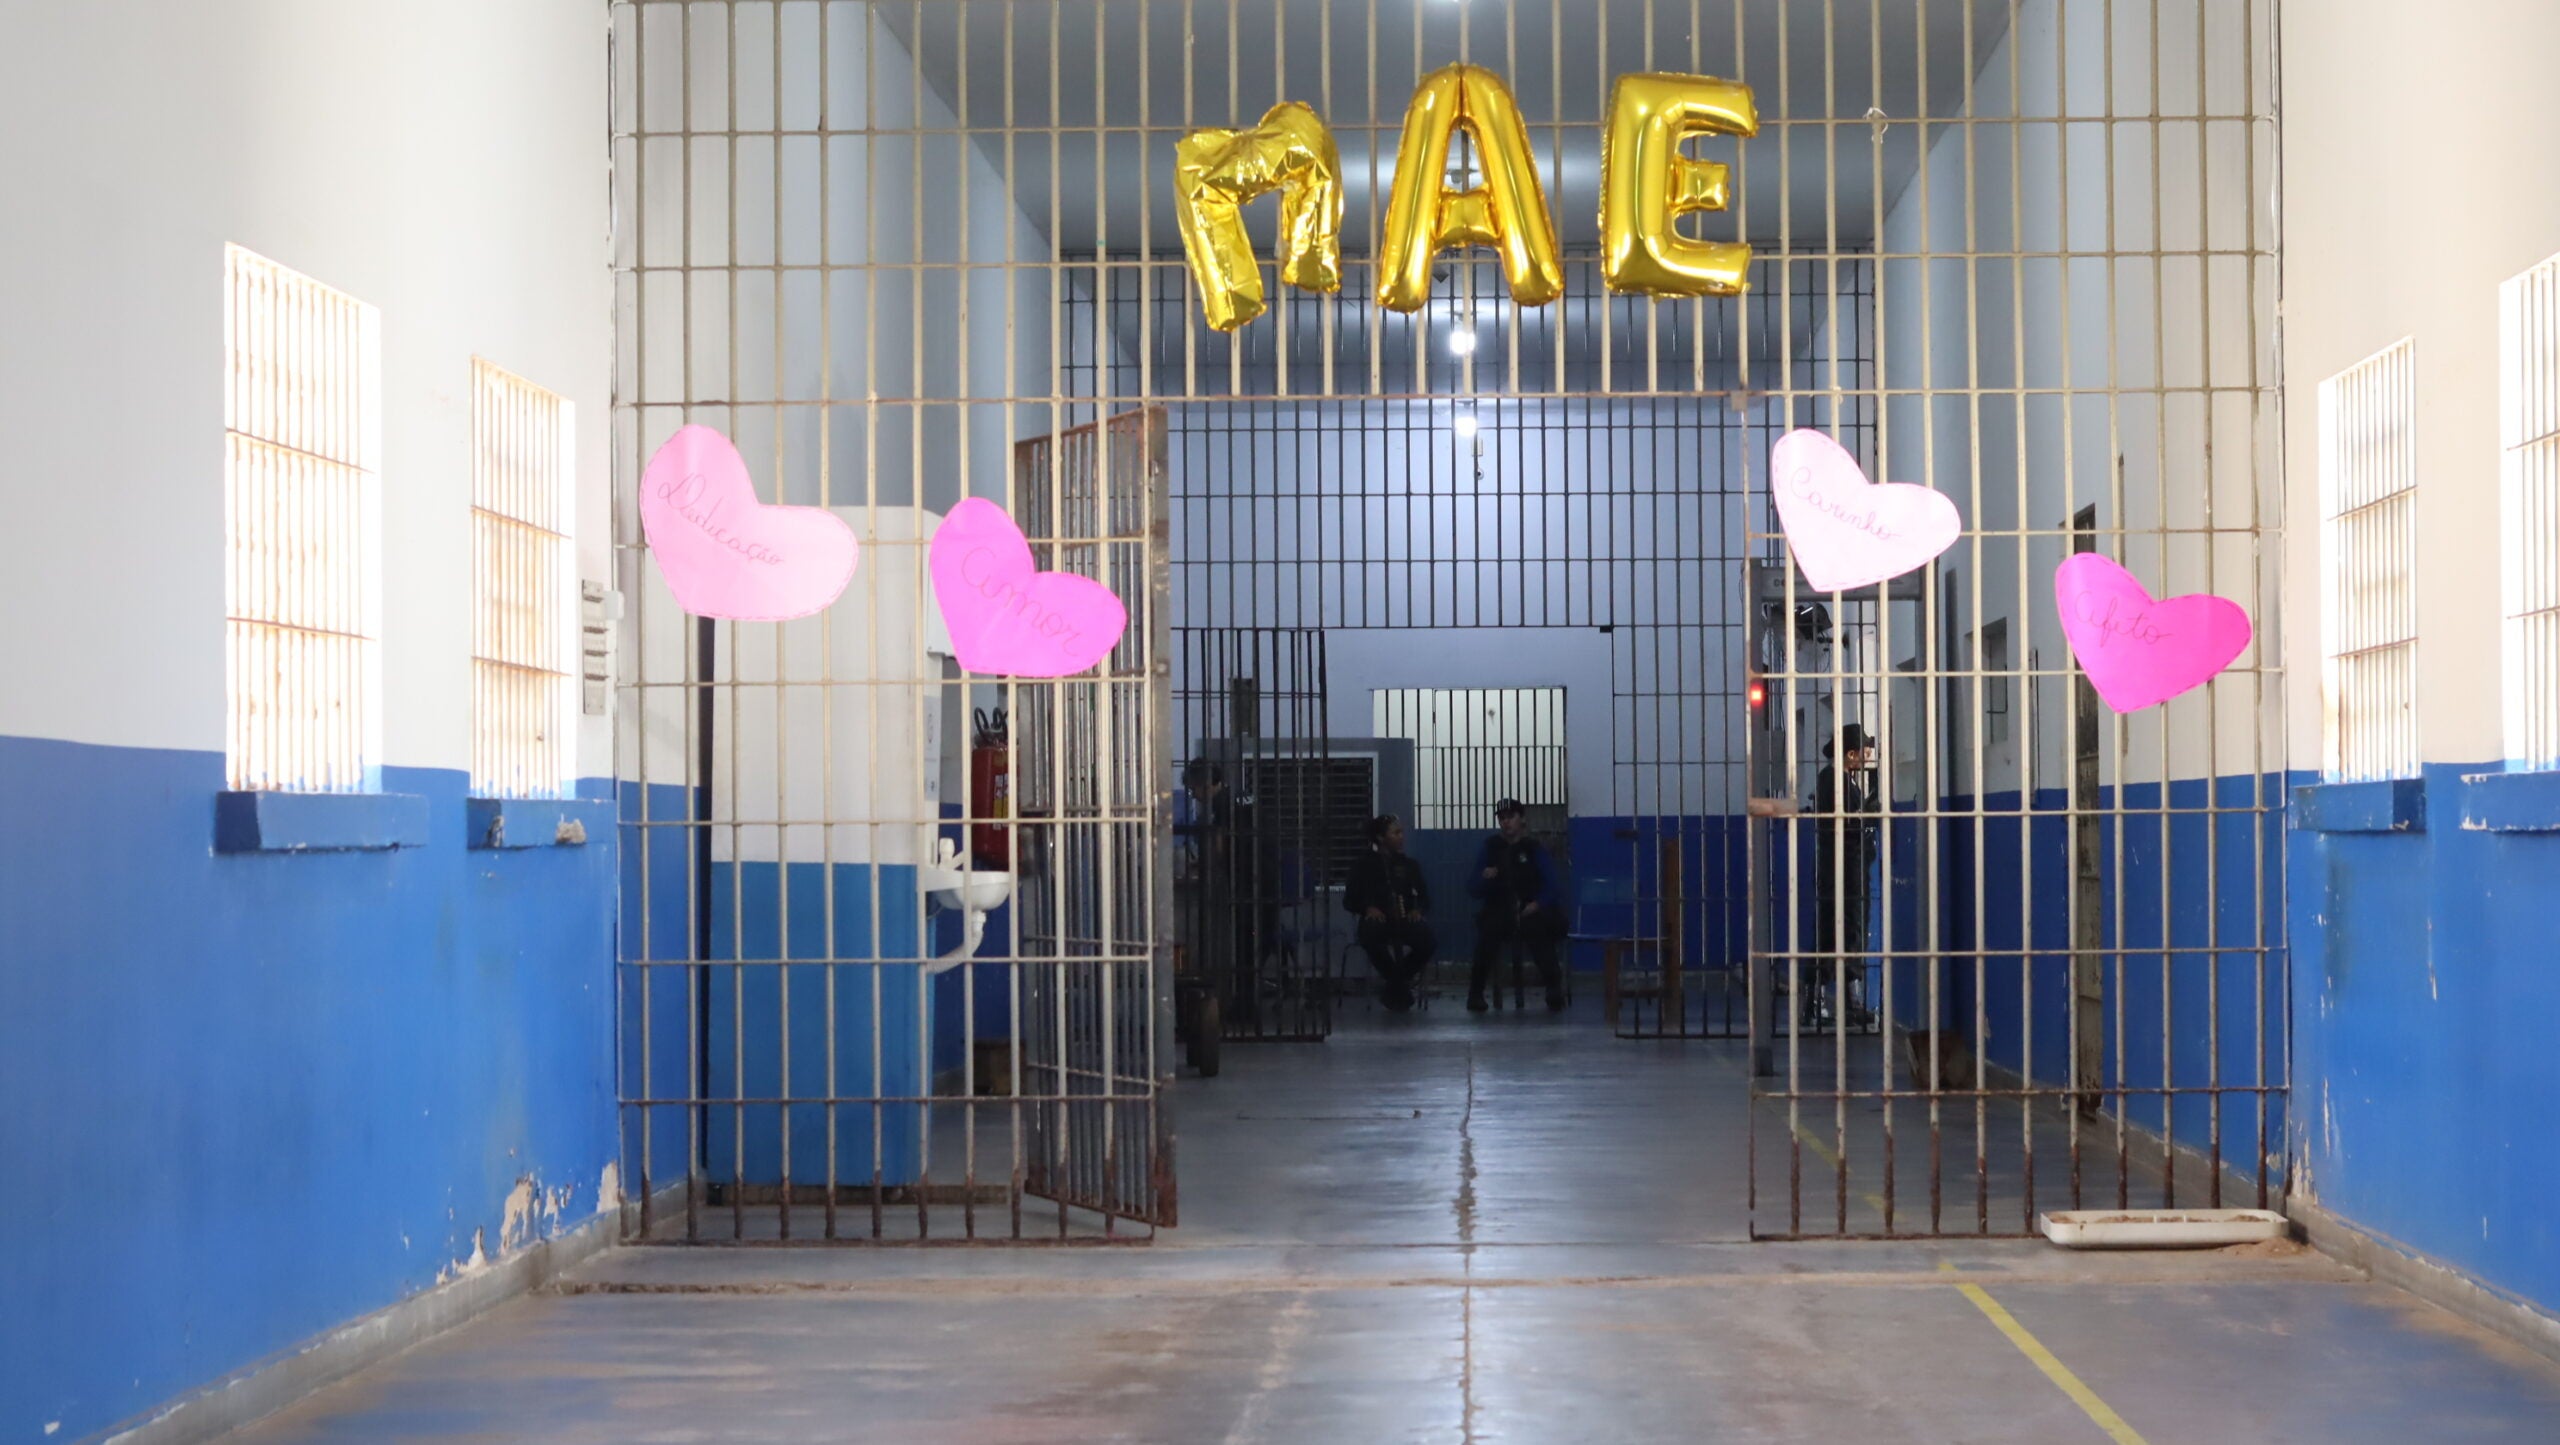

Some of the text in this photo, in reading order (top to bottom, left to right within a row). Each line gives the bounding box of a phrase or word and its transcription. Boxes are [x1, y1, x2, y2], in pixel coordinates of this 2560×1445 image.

[657, 471, 785, 565] Dedicação
[1790, 465, 1905, 541] Carinho
[961, 546, 1083, 657] Amor
[2074, 590, 2175, 648] Afeto
